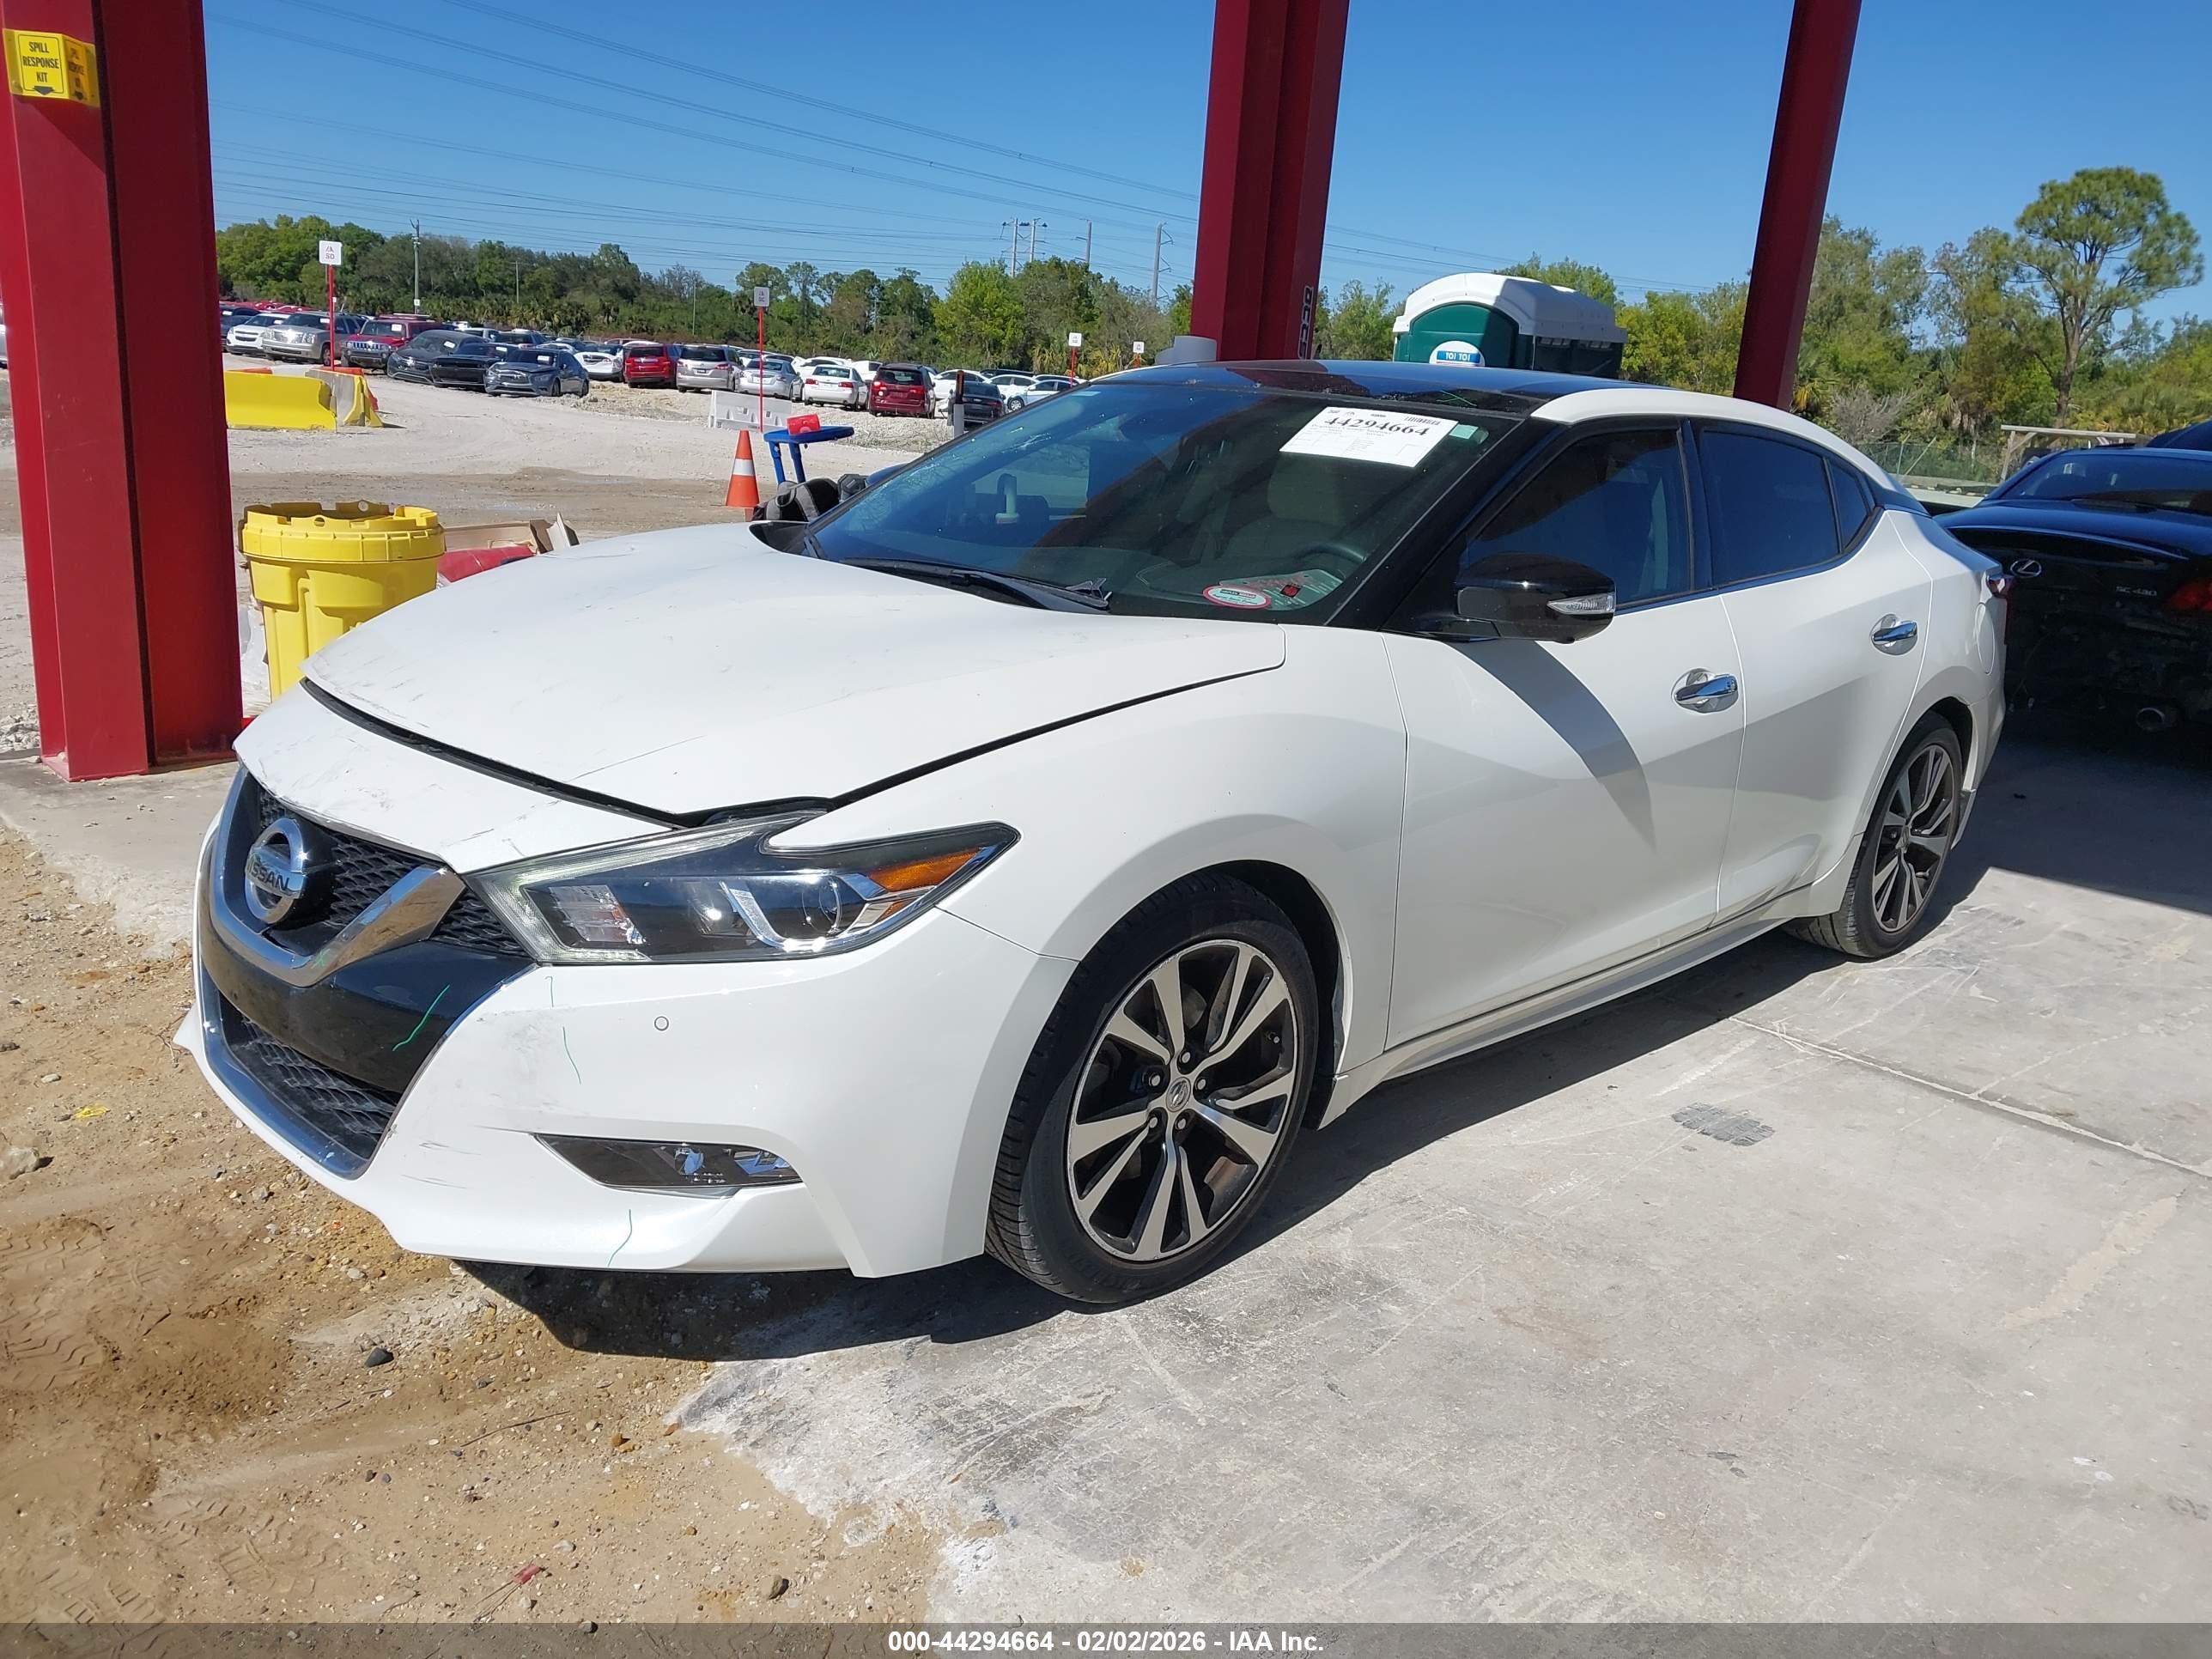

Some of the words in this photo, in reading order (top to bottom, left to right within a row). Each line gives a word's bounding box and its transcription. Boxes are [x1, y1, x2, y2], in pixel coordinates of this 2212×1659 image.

[28, 41, 50, 53] SPILL
[22, 55, 59, 70] RESPONSE
[36, 71, 47, 82] KIT
[1324, 416, 1431, 436] 44294664
